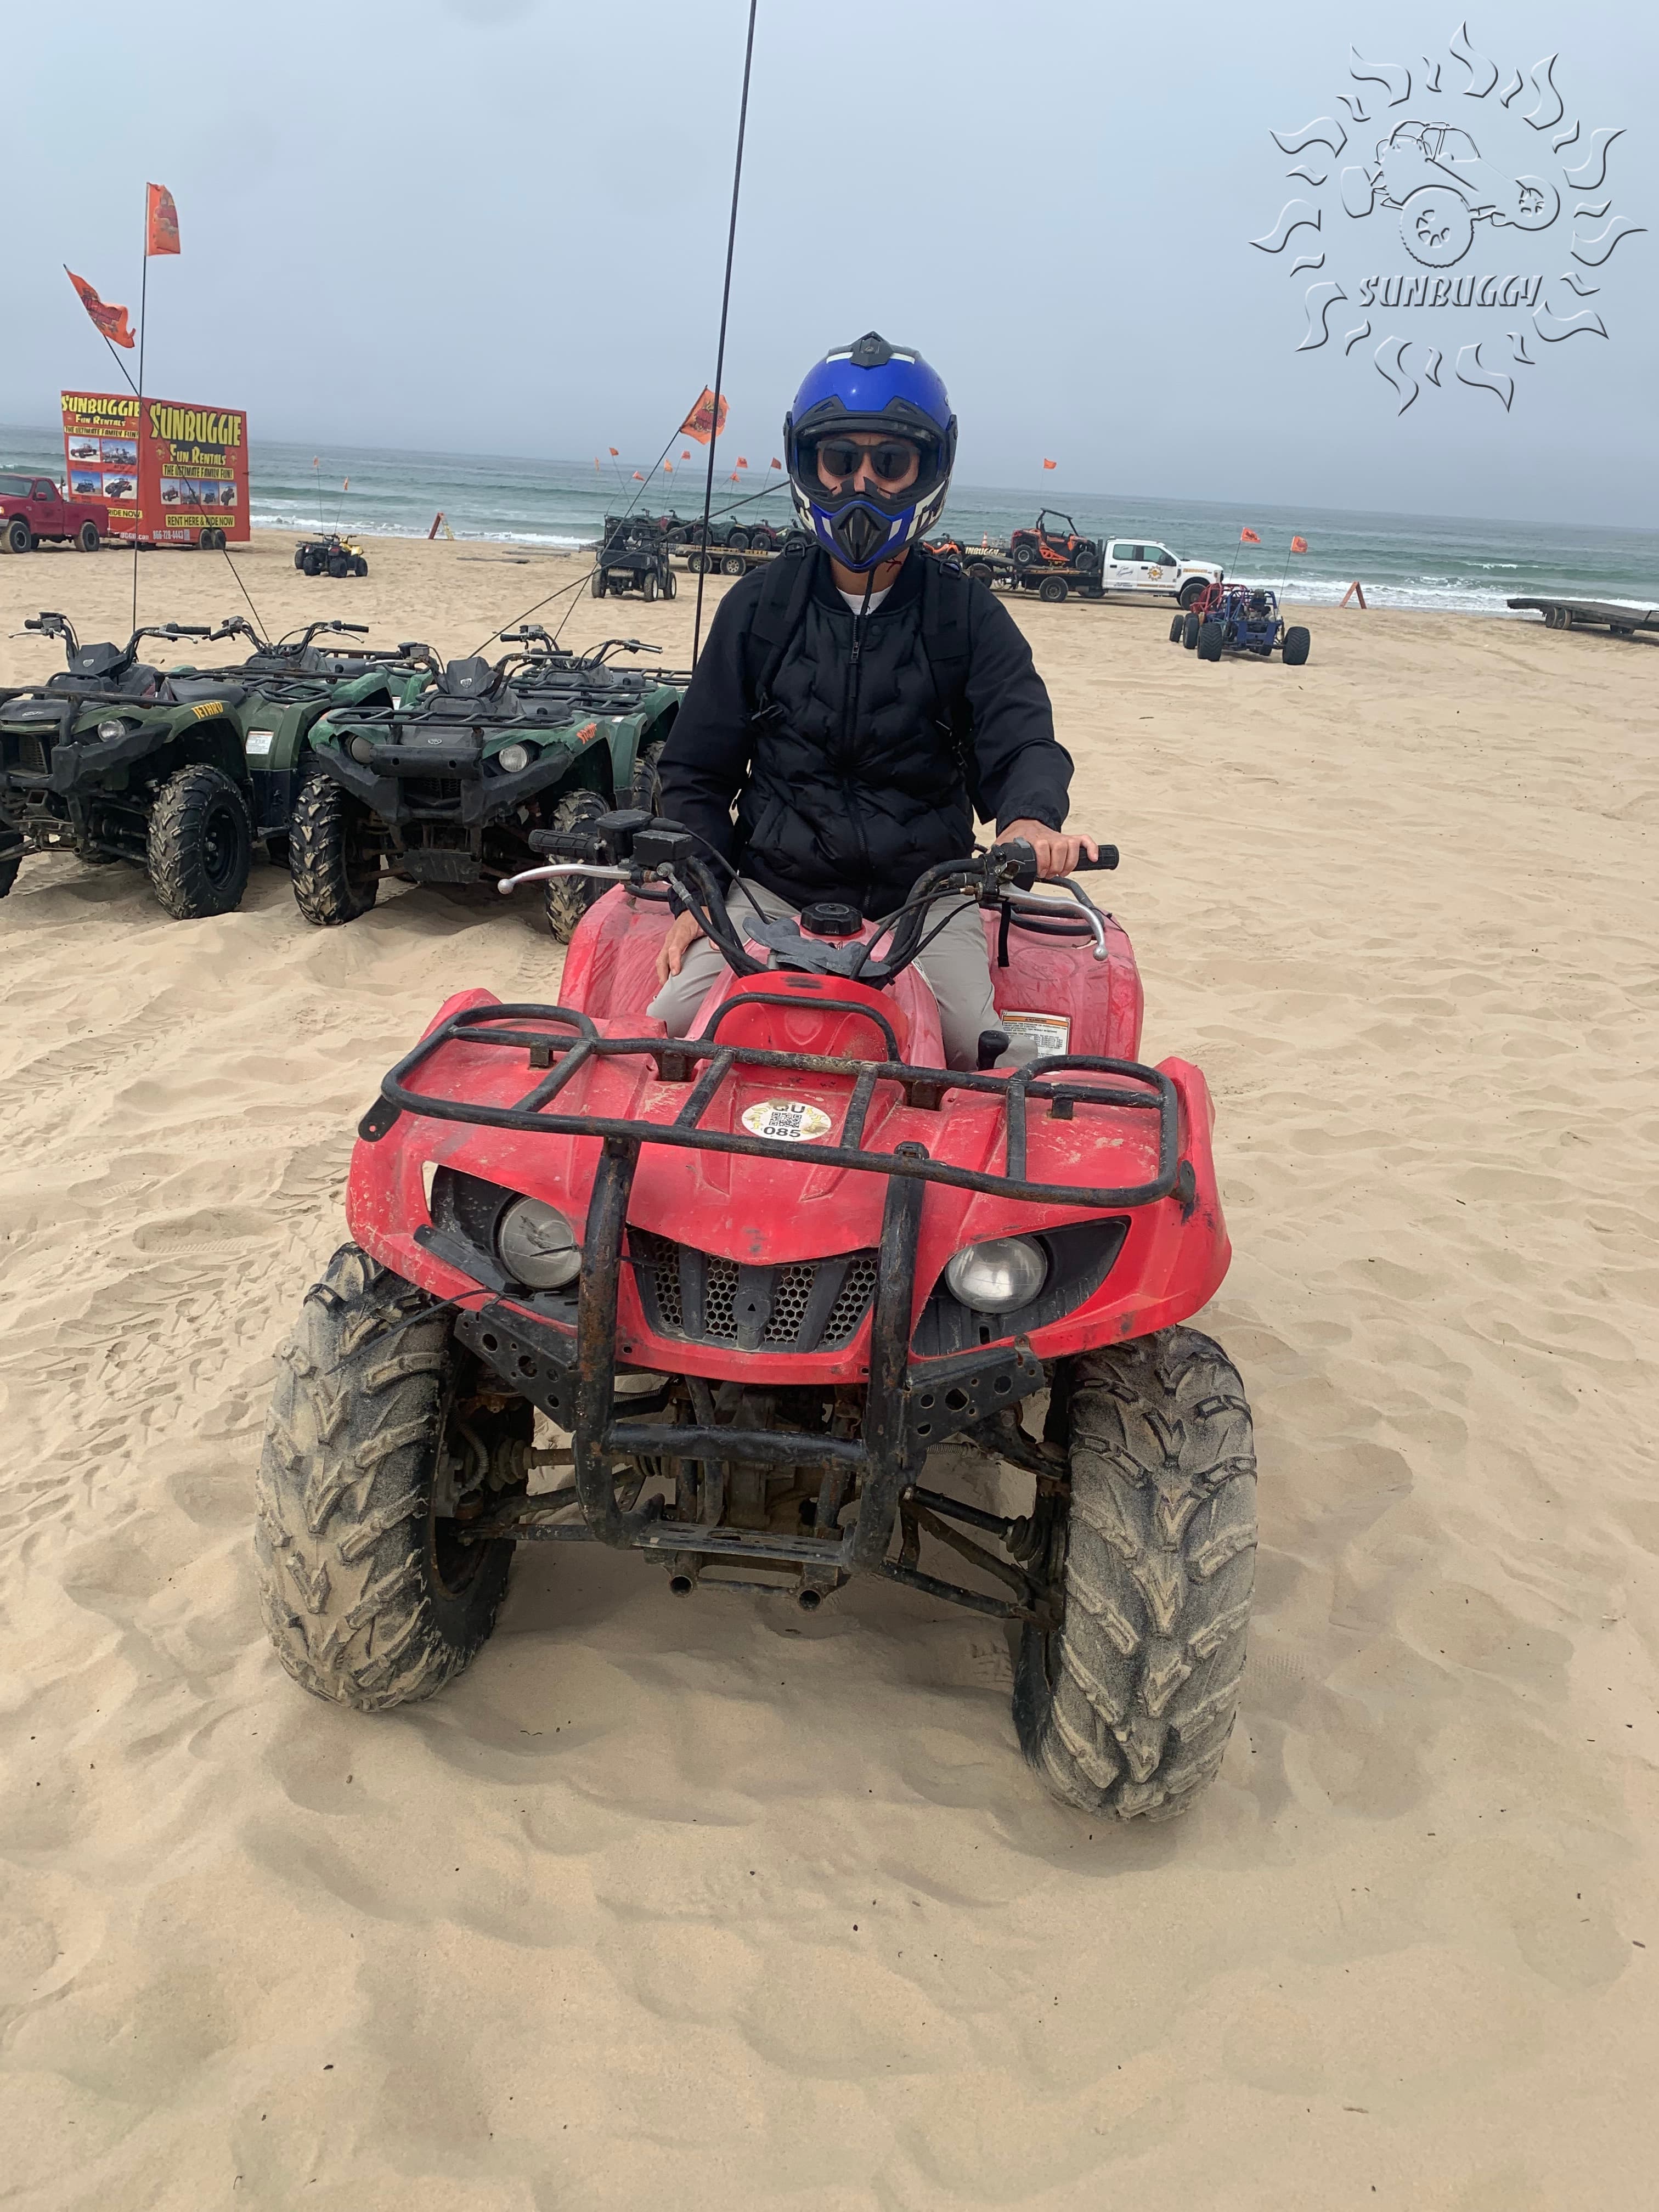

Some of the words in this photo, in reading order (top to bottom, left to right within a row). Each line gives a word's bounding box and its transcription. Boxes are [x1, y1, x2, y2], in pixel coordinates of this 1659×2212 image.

[61, 394, 140, 417] SUNBUGGIE
[150, 403, 241, 445] SUNBUGGIE
[164, 465, 173, 475] THE
[176, 466, 199, 477] ULTIMATE
[201, 467, 218, 478] FAMILY
[221, 469, 233, 479] FUN!
[167, 516, 183, 526] RENT
[184, 516, 199, 526] HERE
[201, 517, 204, 526] &
[206, 517, 218, 526] RIDE
[220, 517, 233, 526] NOW
[764, 1127, 801, 1137] 085
